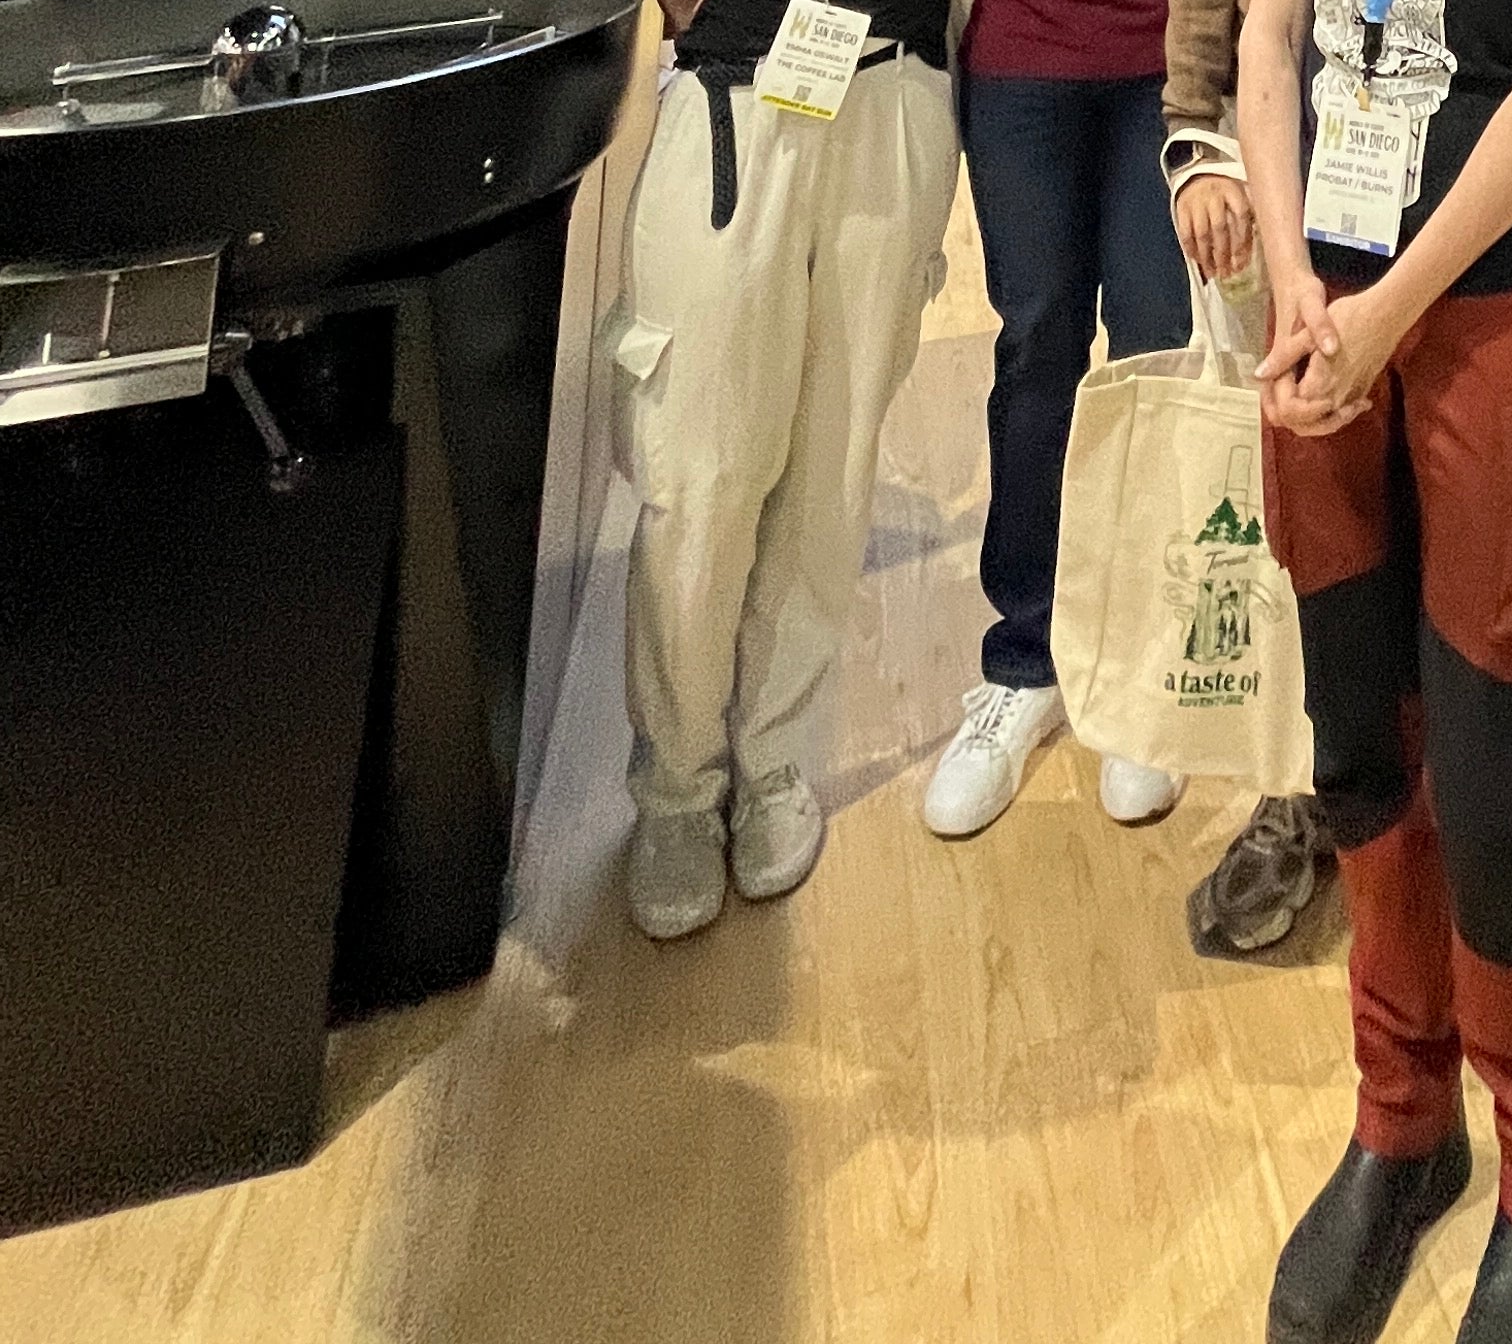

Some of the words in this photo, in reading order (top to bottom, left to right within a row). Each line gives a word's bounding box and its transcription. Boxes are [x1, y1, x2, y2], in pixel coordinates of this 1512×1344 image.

[813, 23, 829, 39] SAN
[830, 28, 859, 47] DIEGO
[1349, 128, 1367, 147] SAN
[1369, 131, 1401, 154] DIEGO
[1324, 158, 1354, 174] JAMIE
[1356, 163, 1389, 180] WILLIS
[1315, 171, 1353, 189] PROBAT
[1360, 180, 1394, 196] BURNS
[1164, 672, 1176, 692] a
[1180, 668, 1236, 694] taste
[1239, 669, 1262, 697] of
